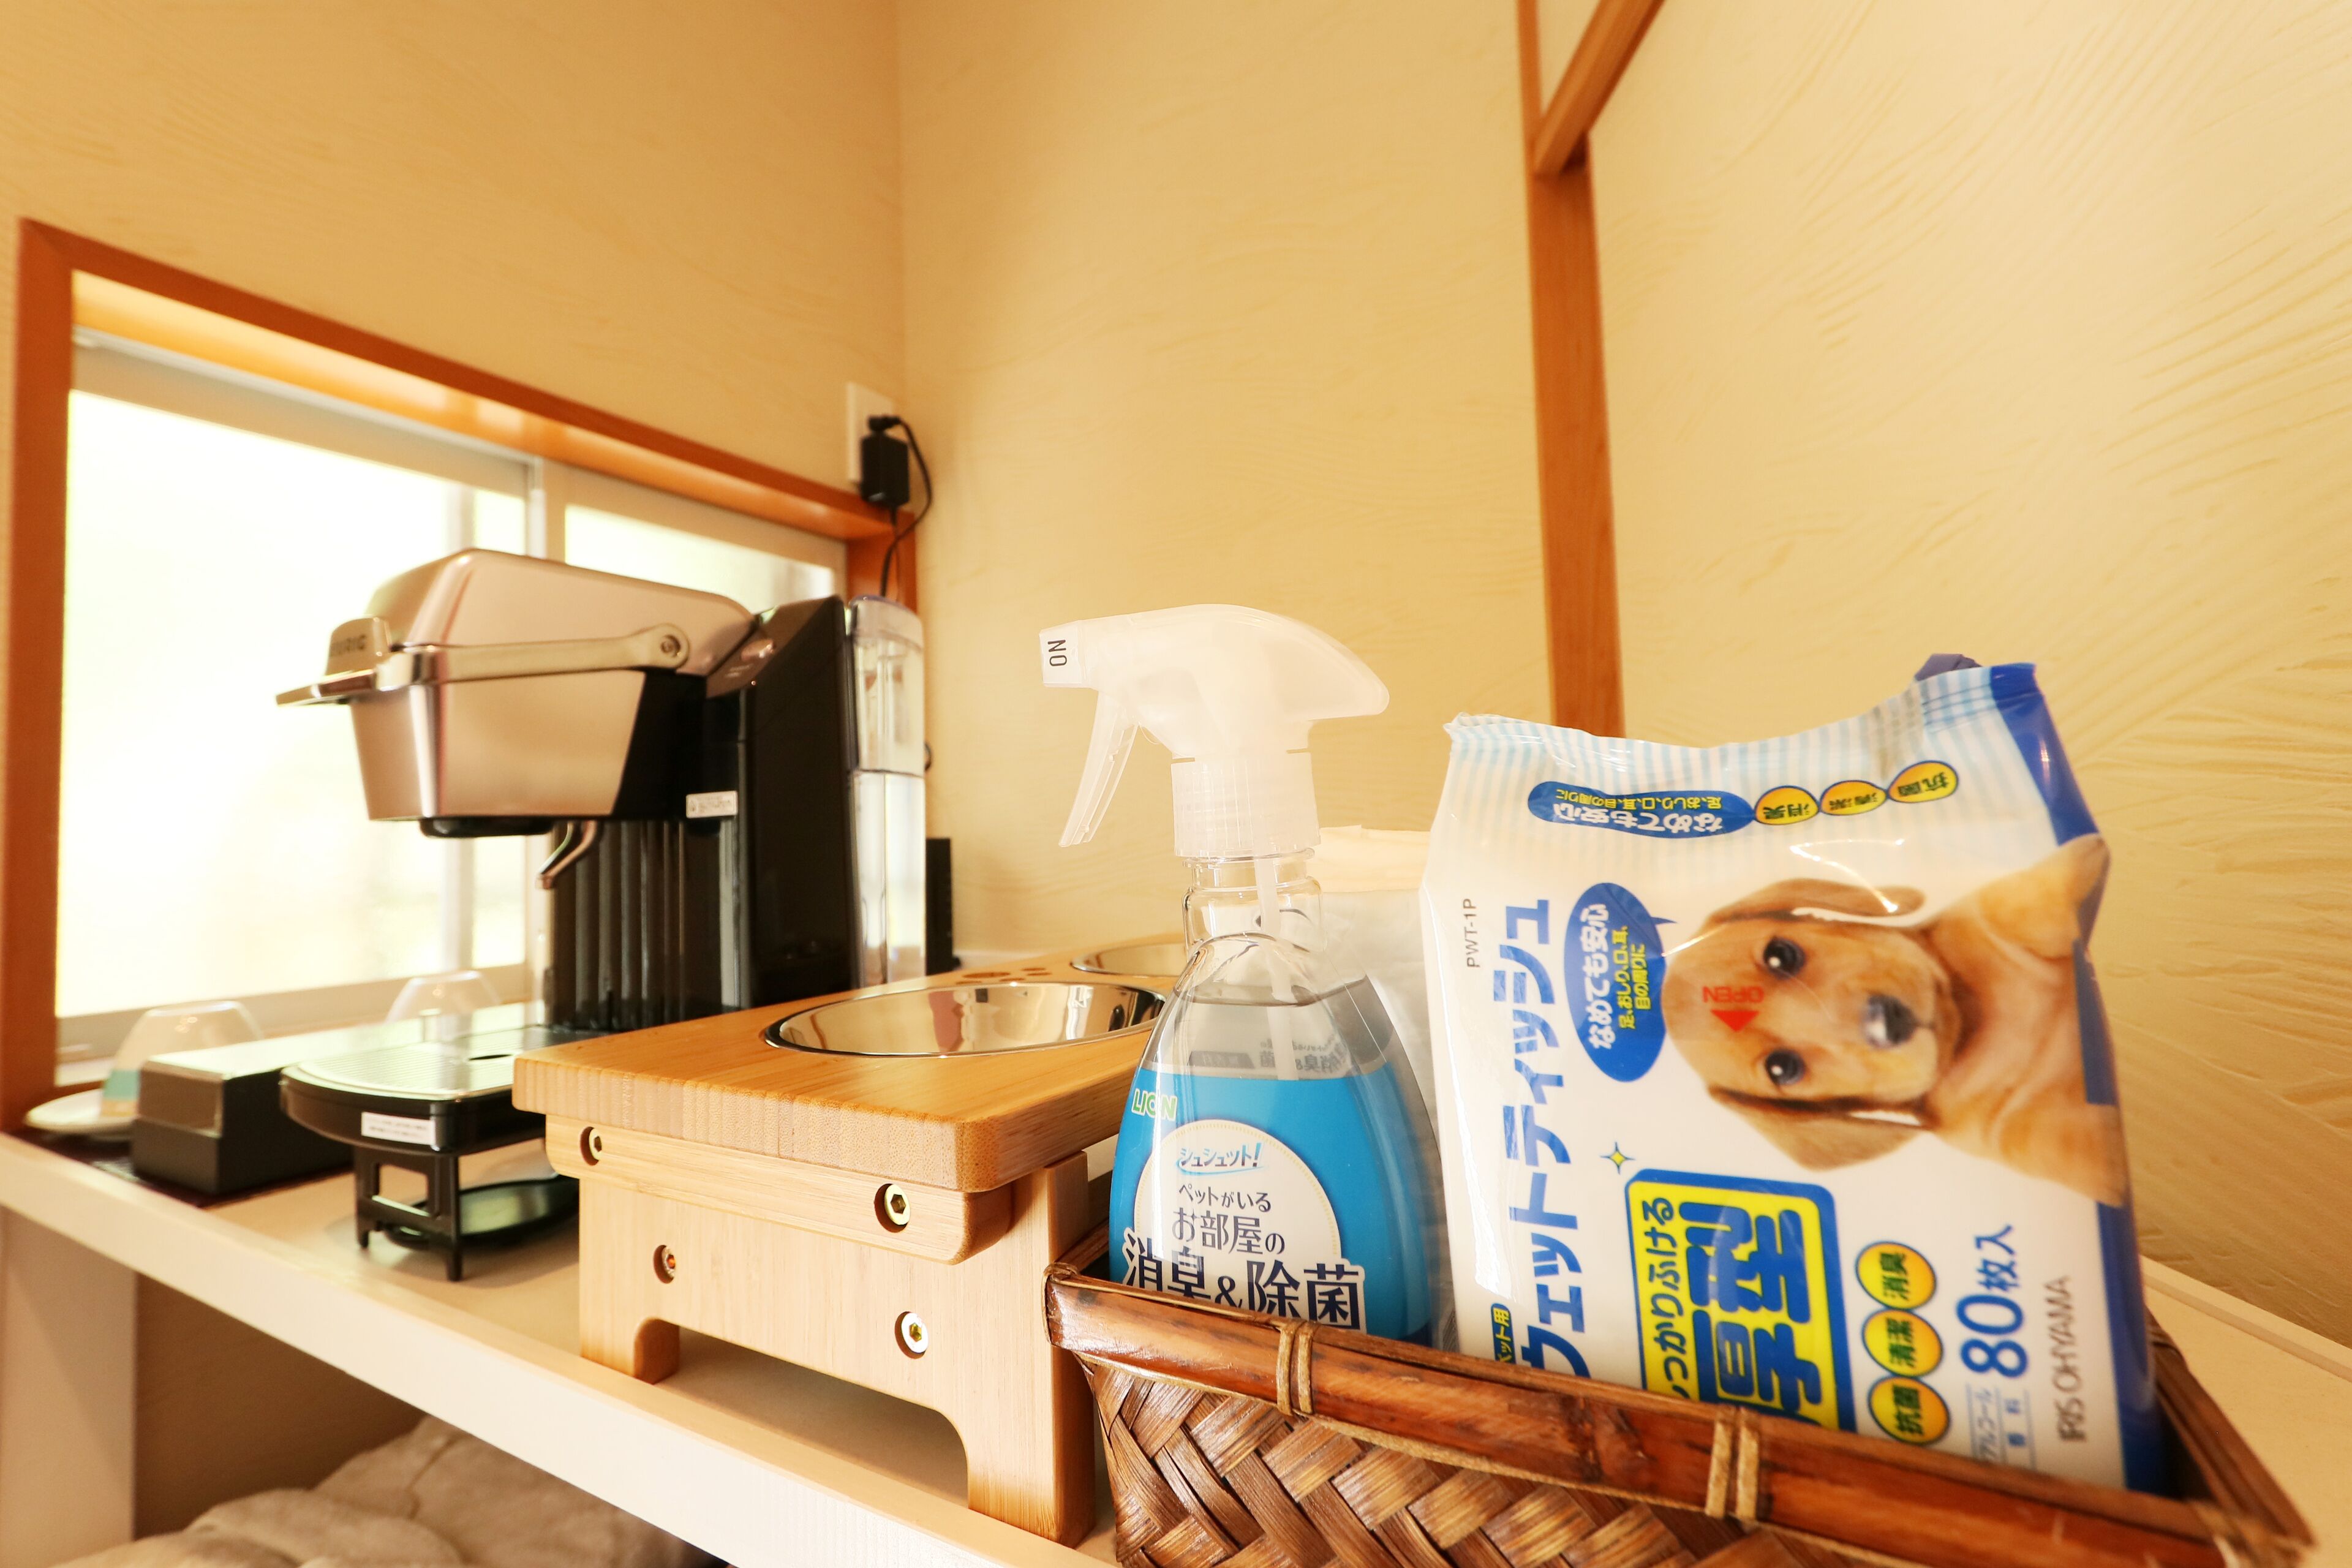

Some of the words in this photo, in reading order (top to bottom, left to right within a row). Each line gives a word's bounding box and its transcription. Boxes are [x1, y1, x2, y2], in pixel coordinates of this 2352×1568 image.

[1047, 639, 1068, 667] ON
[1897, 771, 1950, 797] 抗菌
[1552, 802, 1723, 834] なめても安心
[1763, 803, 1810, 820] 消臭
[1462, 898, 1480, 968] PWT-1P
[1580, 903, 1616, 1049] なめても安心
[1630, 943, 1651, 1011] 目の周りに
[1702, 985, 1764, 1003] OPEN
[1132, 1089, 1177, 1121] LION
[1493, 899, 1593, 1379] ウェットティッシュ
[1178, 1183, 1272, 1213] ペットがいる
[1171, 1207, 1286, 1254] お部屋の
[1126, 1232, 1360, 1330] 消臭&除菌
[1879, 1251, 1910, 1301] 消臭
[1956, 1224, 2029, 1378] 80枚入
[1679, 1201, 1823, 1426] 厚型
[1885, 1317, 1917, 1368] 清潔
[1892, 1384, 1924, 1436] 抗菌
